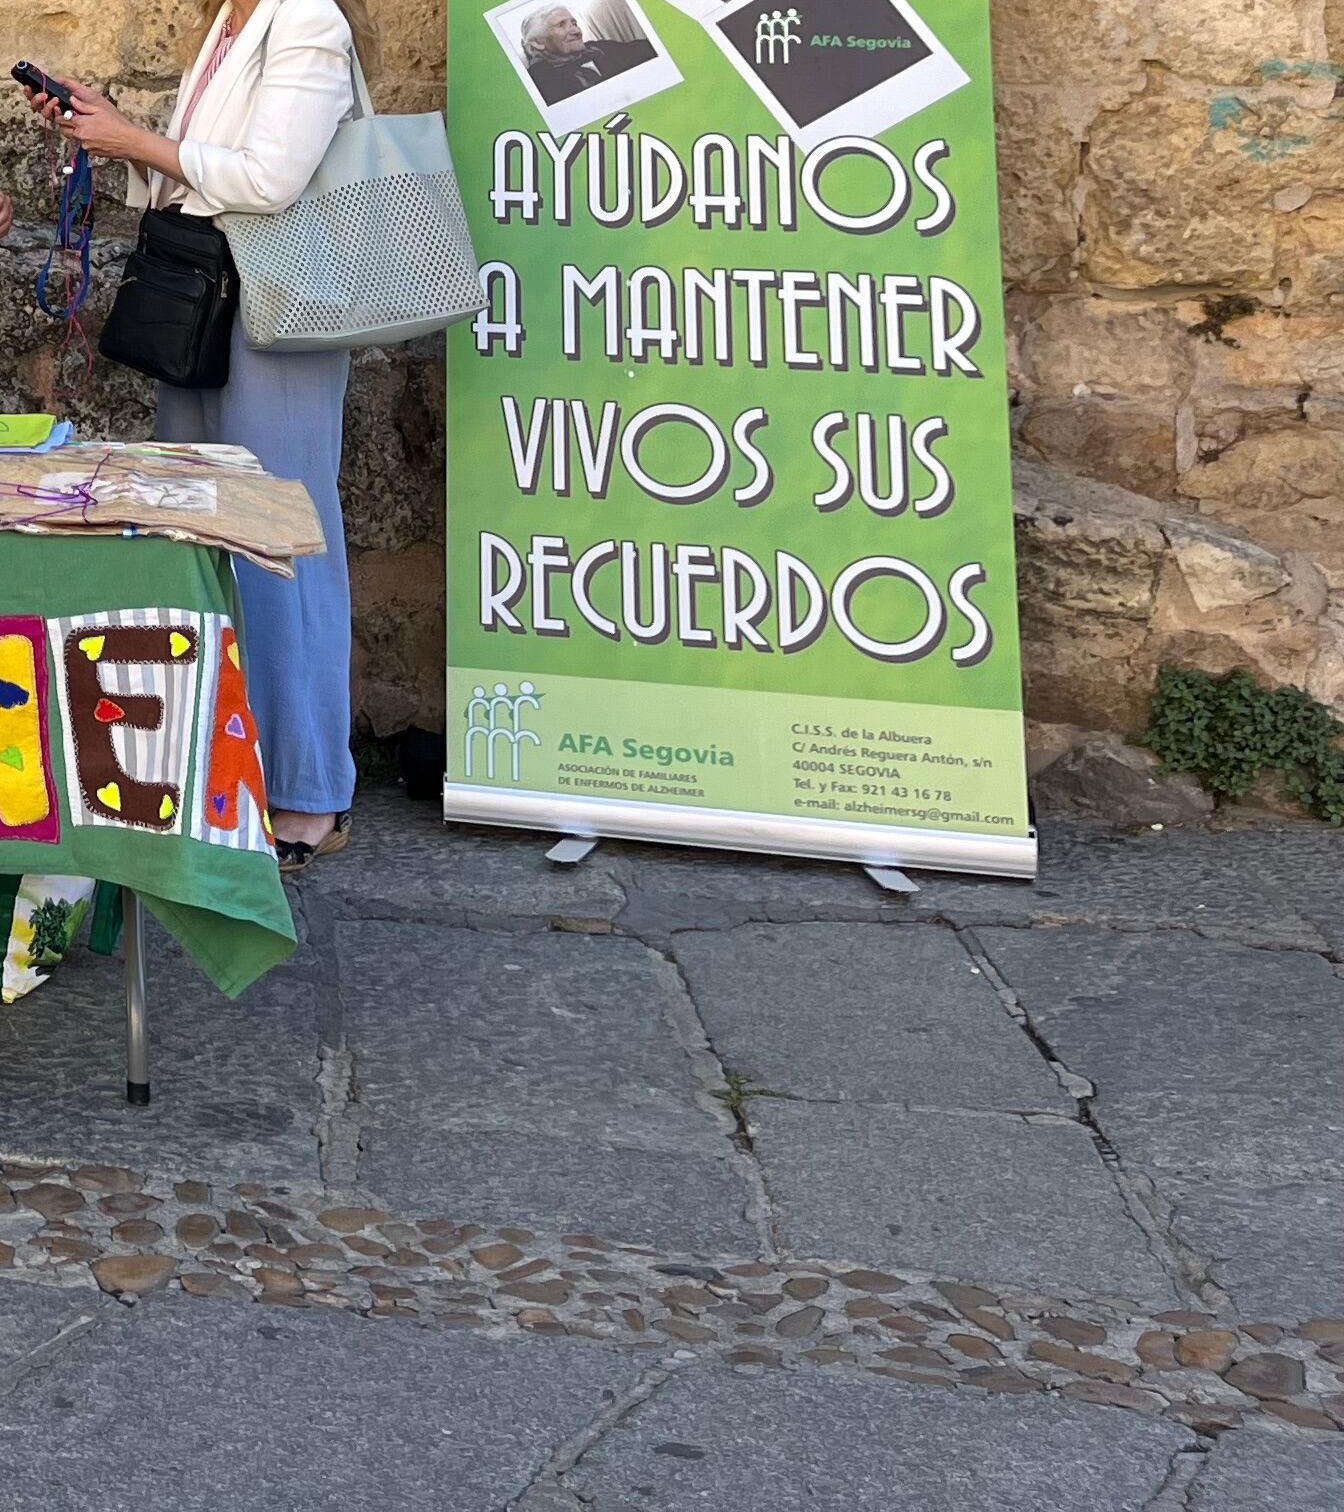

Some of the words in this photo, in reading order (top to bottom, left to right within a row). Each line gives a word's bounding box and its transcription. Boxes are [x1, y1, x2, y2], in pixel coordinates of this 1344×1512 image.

[810, 35, 843, 47] AFA
[847, 36, 912, 51] Segovia
[489, 113, 955, 236] AYÚDANOS
[472, 261, 525, 357] A
[562, 264, 984, 377] MANTENER
[501, 396, 774, 508] VIVOS
[812, 410, 955, 518] SUS
[479, 531, 993, 667] RECUERDOS
[558, 733, 614, 756] AFA
[622, 738, 734, 767] Segovia
[841, 728, 858, 739] de
[862, 729, 874, 740] la
[878, 731, 932, 745] Albuera
[792, 741, 806, 753] C/
[809, 743, 857, 757] Andrés
[861, 747, 917, 762] Reguera
[921, 753, 968, 767] Antón,
[972, 757, 992, 768] s/n
[558, 763, 620, 777] ASOCIACIÓN
[623, 769, 636, 778] DE
[639, 770, 697, 783] FAMILIARES
[792, 760, 835, 772] 40004
[839, 763, 901, 779] SEGOVIA
[558, 776, 570, 786] DE
[575, 777, 629, 791] ENFERMOS
[631, 783, 644, 792] DE
[647, 784, 705, 797] ALZHEIMER
[793, 778, 815, 789] Tel.
[818, 782, 827, 793] y
[862, 784, 886, 795] 921
[891, 786, 909, 797] 43
[914, 788, 930, 799] 16
[935, 790, 952, 801] 78
[794, 798, 840, 810] e-mail:
[844, 800, 1015, 825] alzheimersg@gmail.com
